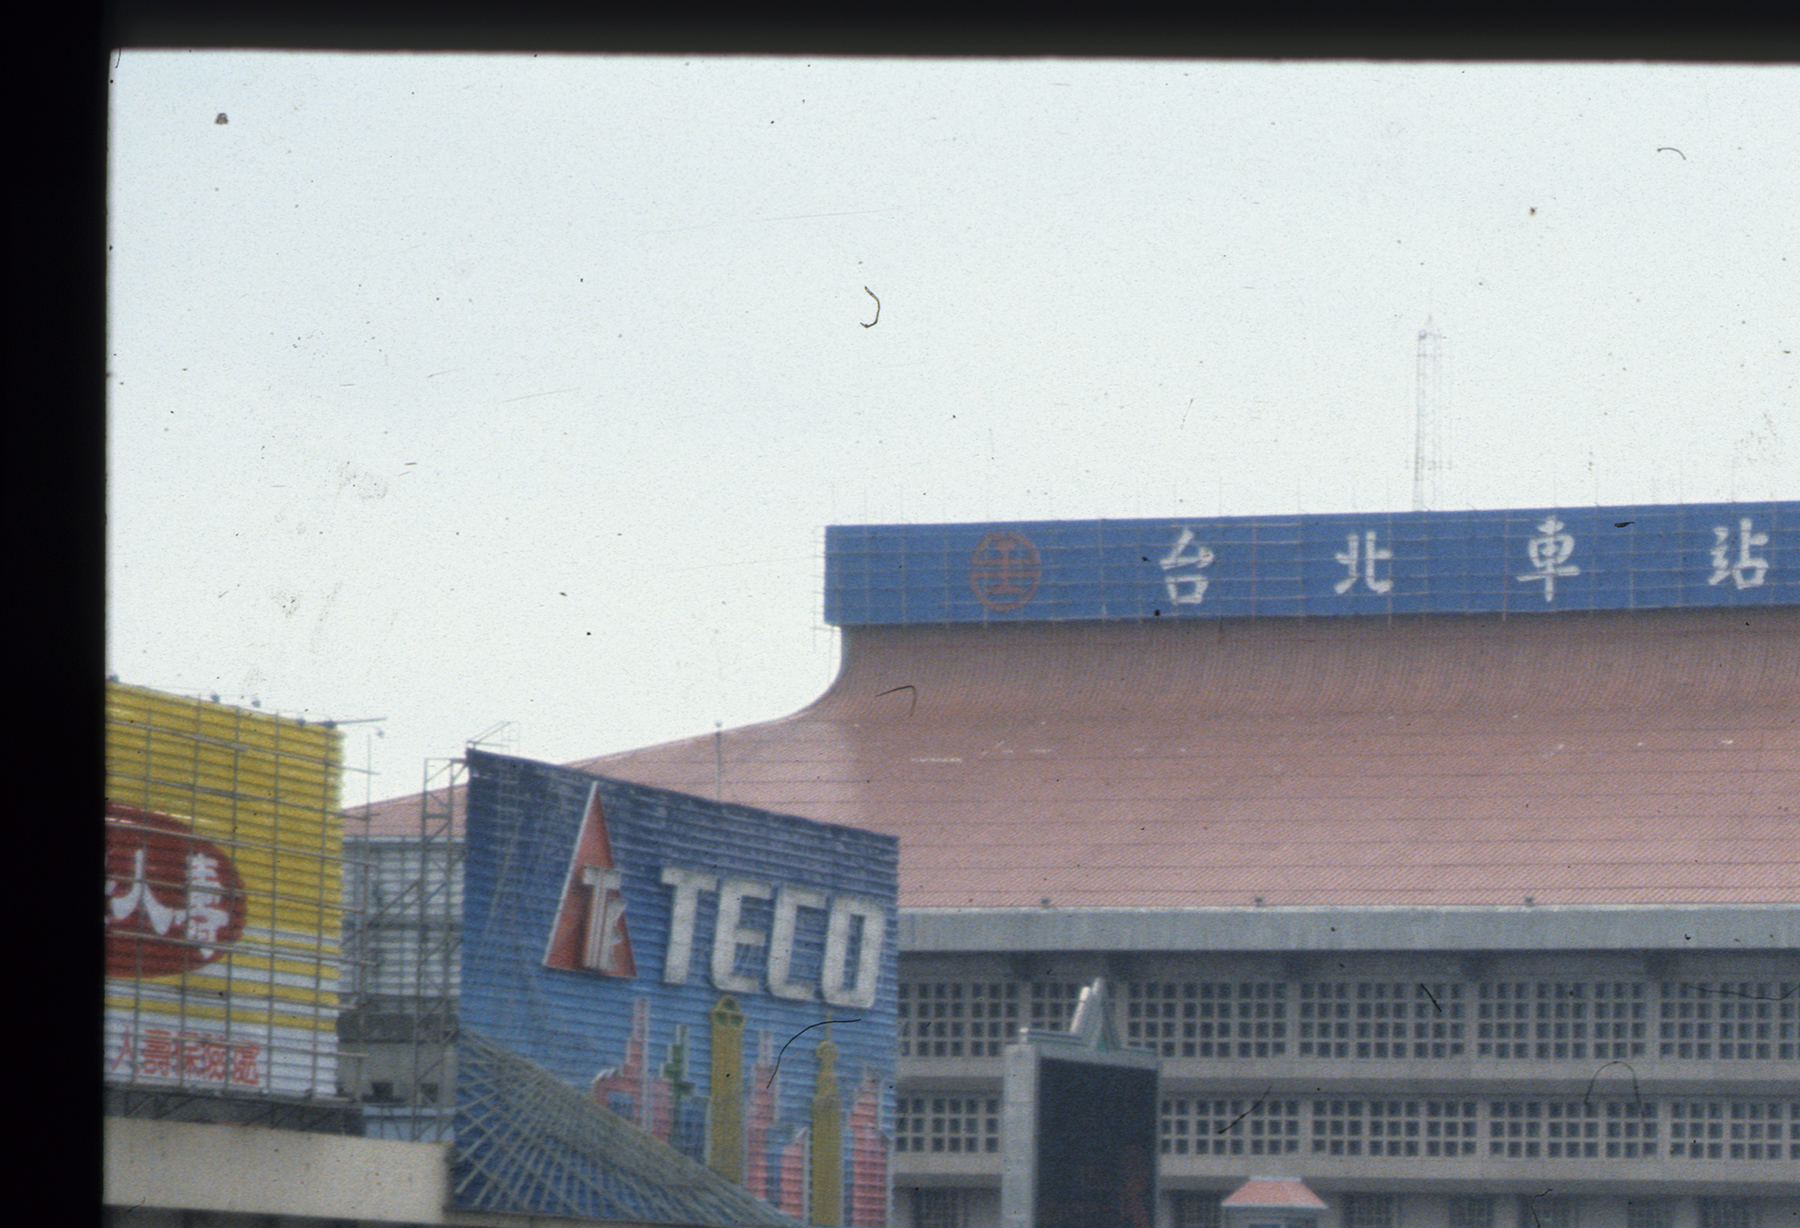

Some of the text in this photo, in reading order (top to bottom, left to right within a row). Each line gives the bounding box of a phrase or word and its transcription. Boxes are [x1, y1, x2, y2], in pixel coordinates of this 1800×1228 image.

[1159, 517, 1770, 606] 台北車站
[105, 849, 229, 958] 人壽
[661, 867, 888, 1009] TECO
